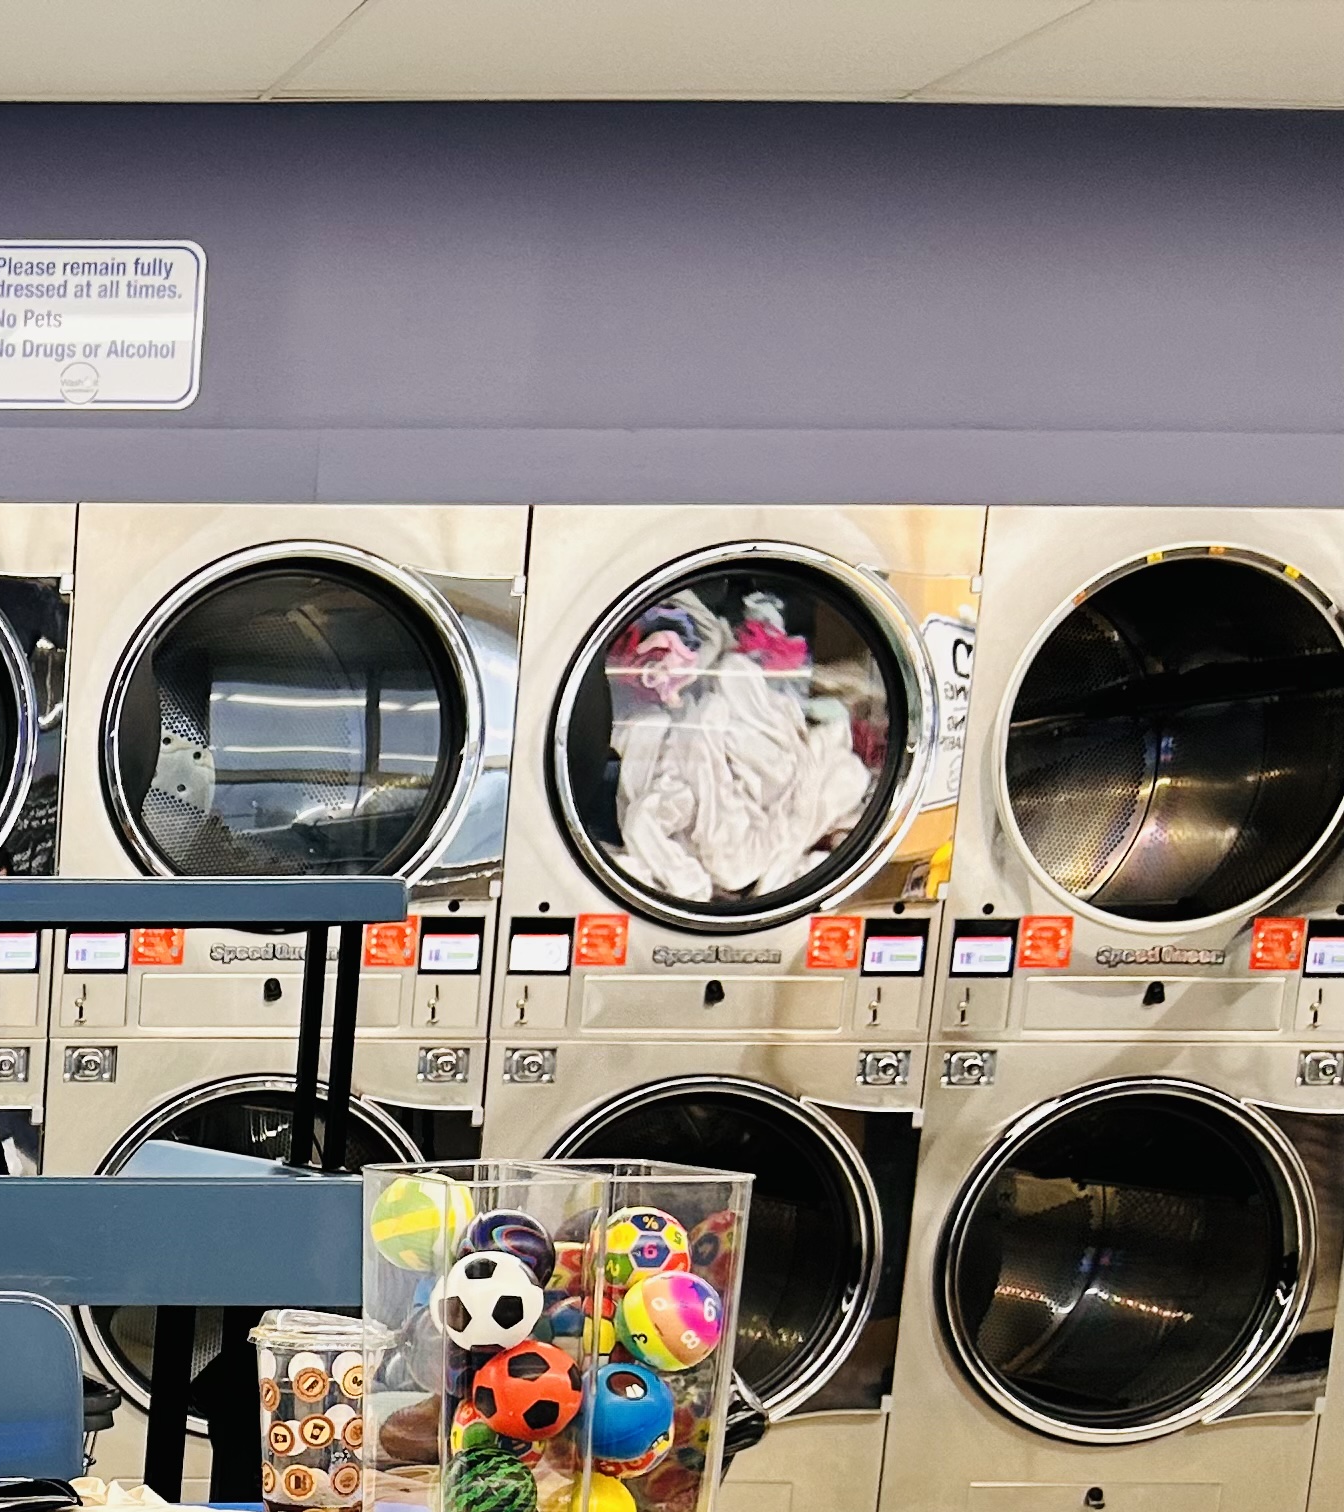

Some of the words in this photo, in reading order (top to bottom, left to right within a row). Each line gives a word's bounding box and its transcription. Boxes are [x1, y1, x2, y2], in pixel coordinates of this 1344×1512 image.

[63, 258, 126, 276] remain
[134, 257, 173, 280] fully
[74, 281, 92, 298] at
[98, 280, 119, 298] all
[126, 280, 183, 298] times.
[24, 309, 62, 328] Pets
[22, 339, 76, 362] Drugs
[82, 343, 98, 358] or
[107, 340, 175, 359] Alcohol
[210, 943, 275, 965] Speed
[1096, 944, 1161, 968] Speed
